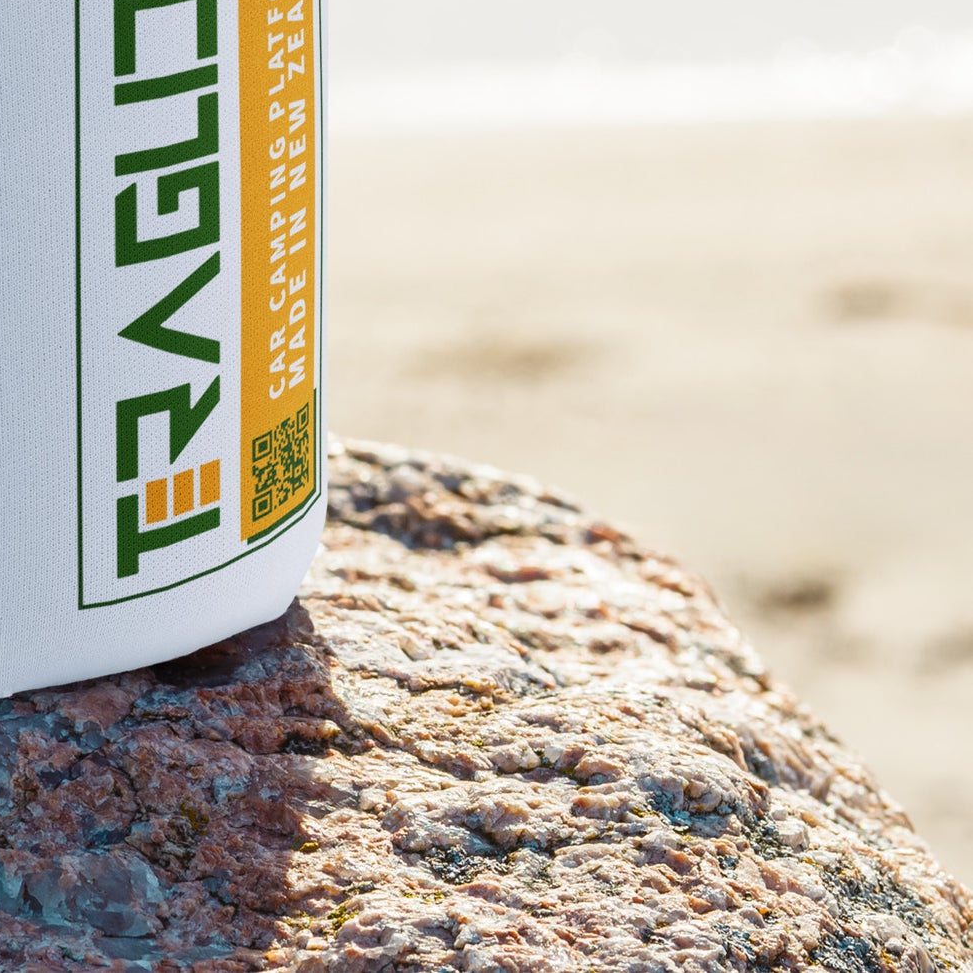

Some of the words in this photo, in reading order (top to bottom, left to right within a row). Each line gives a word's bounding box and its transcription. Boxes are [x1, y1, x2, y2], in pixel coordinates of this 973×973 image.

[288, 98, 306, 191] NEW
[268, 135, 286, 312] CAMPING
[289, 207, 307, 256] IN
[268, 324, 286, 400] CAR
[288, 269, 306, 390] MADE
